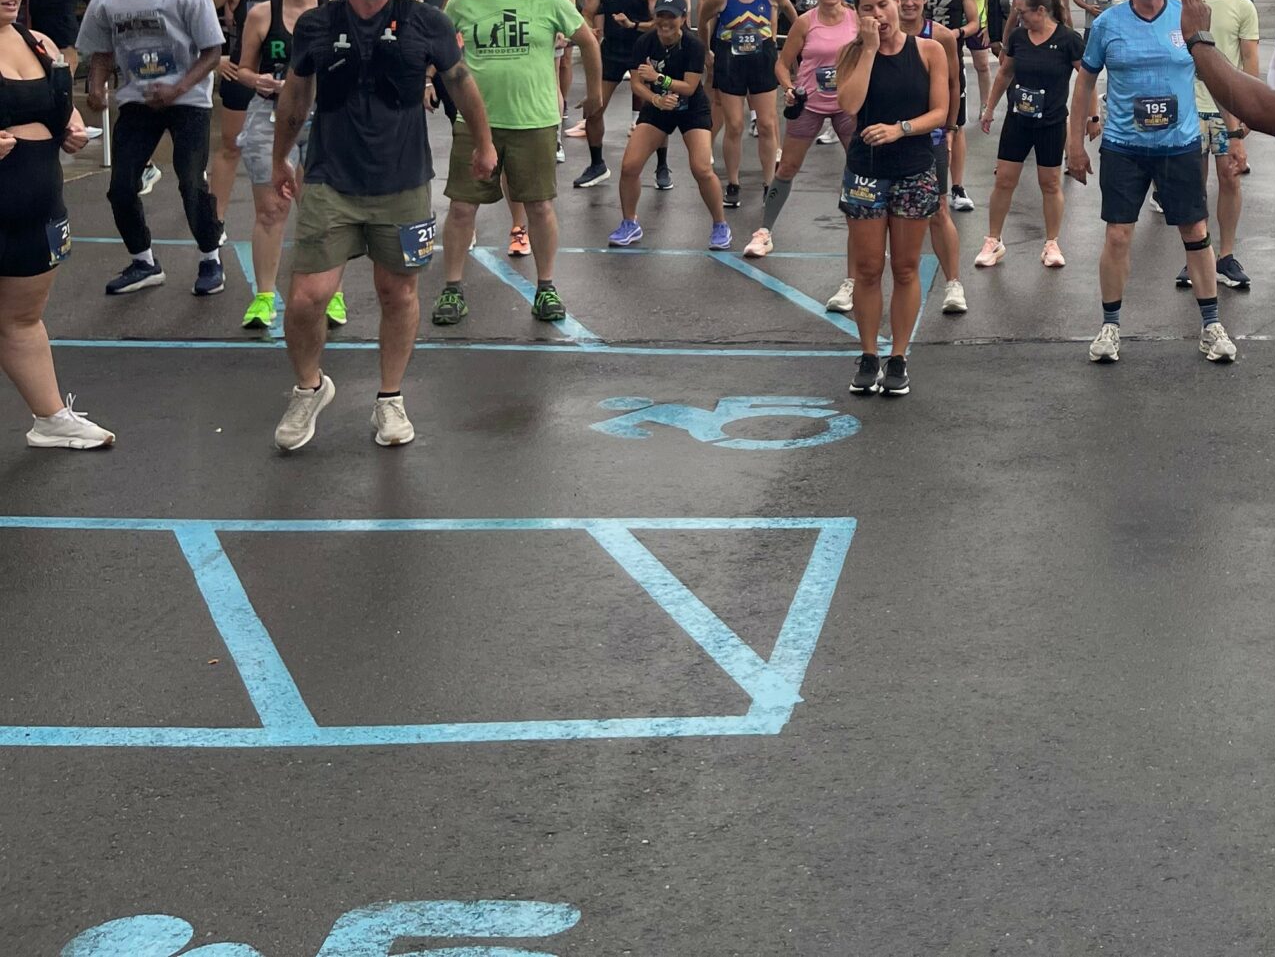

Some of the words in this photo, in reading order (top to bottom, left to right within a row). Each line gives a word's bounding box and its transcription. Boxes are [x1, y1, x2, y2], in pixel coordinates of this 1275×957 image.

[738, 35, 756, 43] 225
[271, 40, 287, 59] R
[142, 52, 159, 64] 95
[1021, 92, 1034, 102] 94
[1145, 103, 1168, 114] 195
[854, 174, 878, 188] 102
